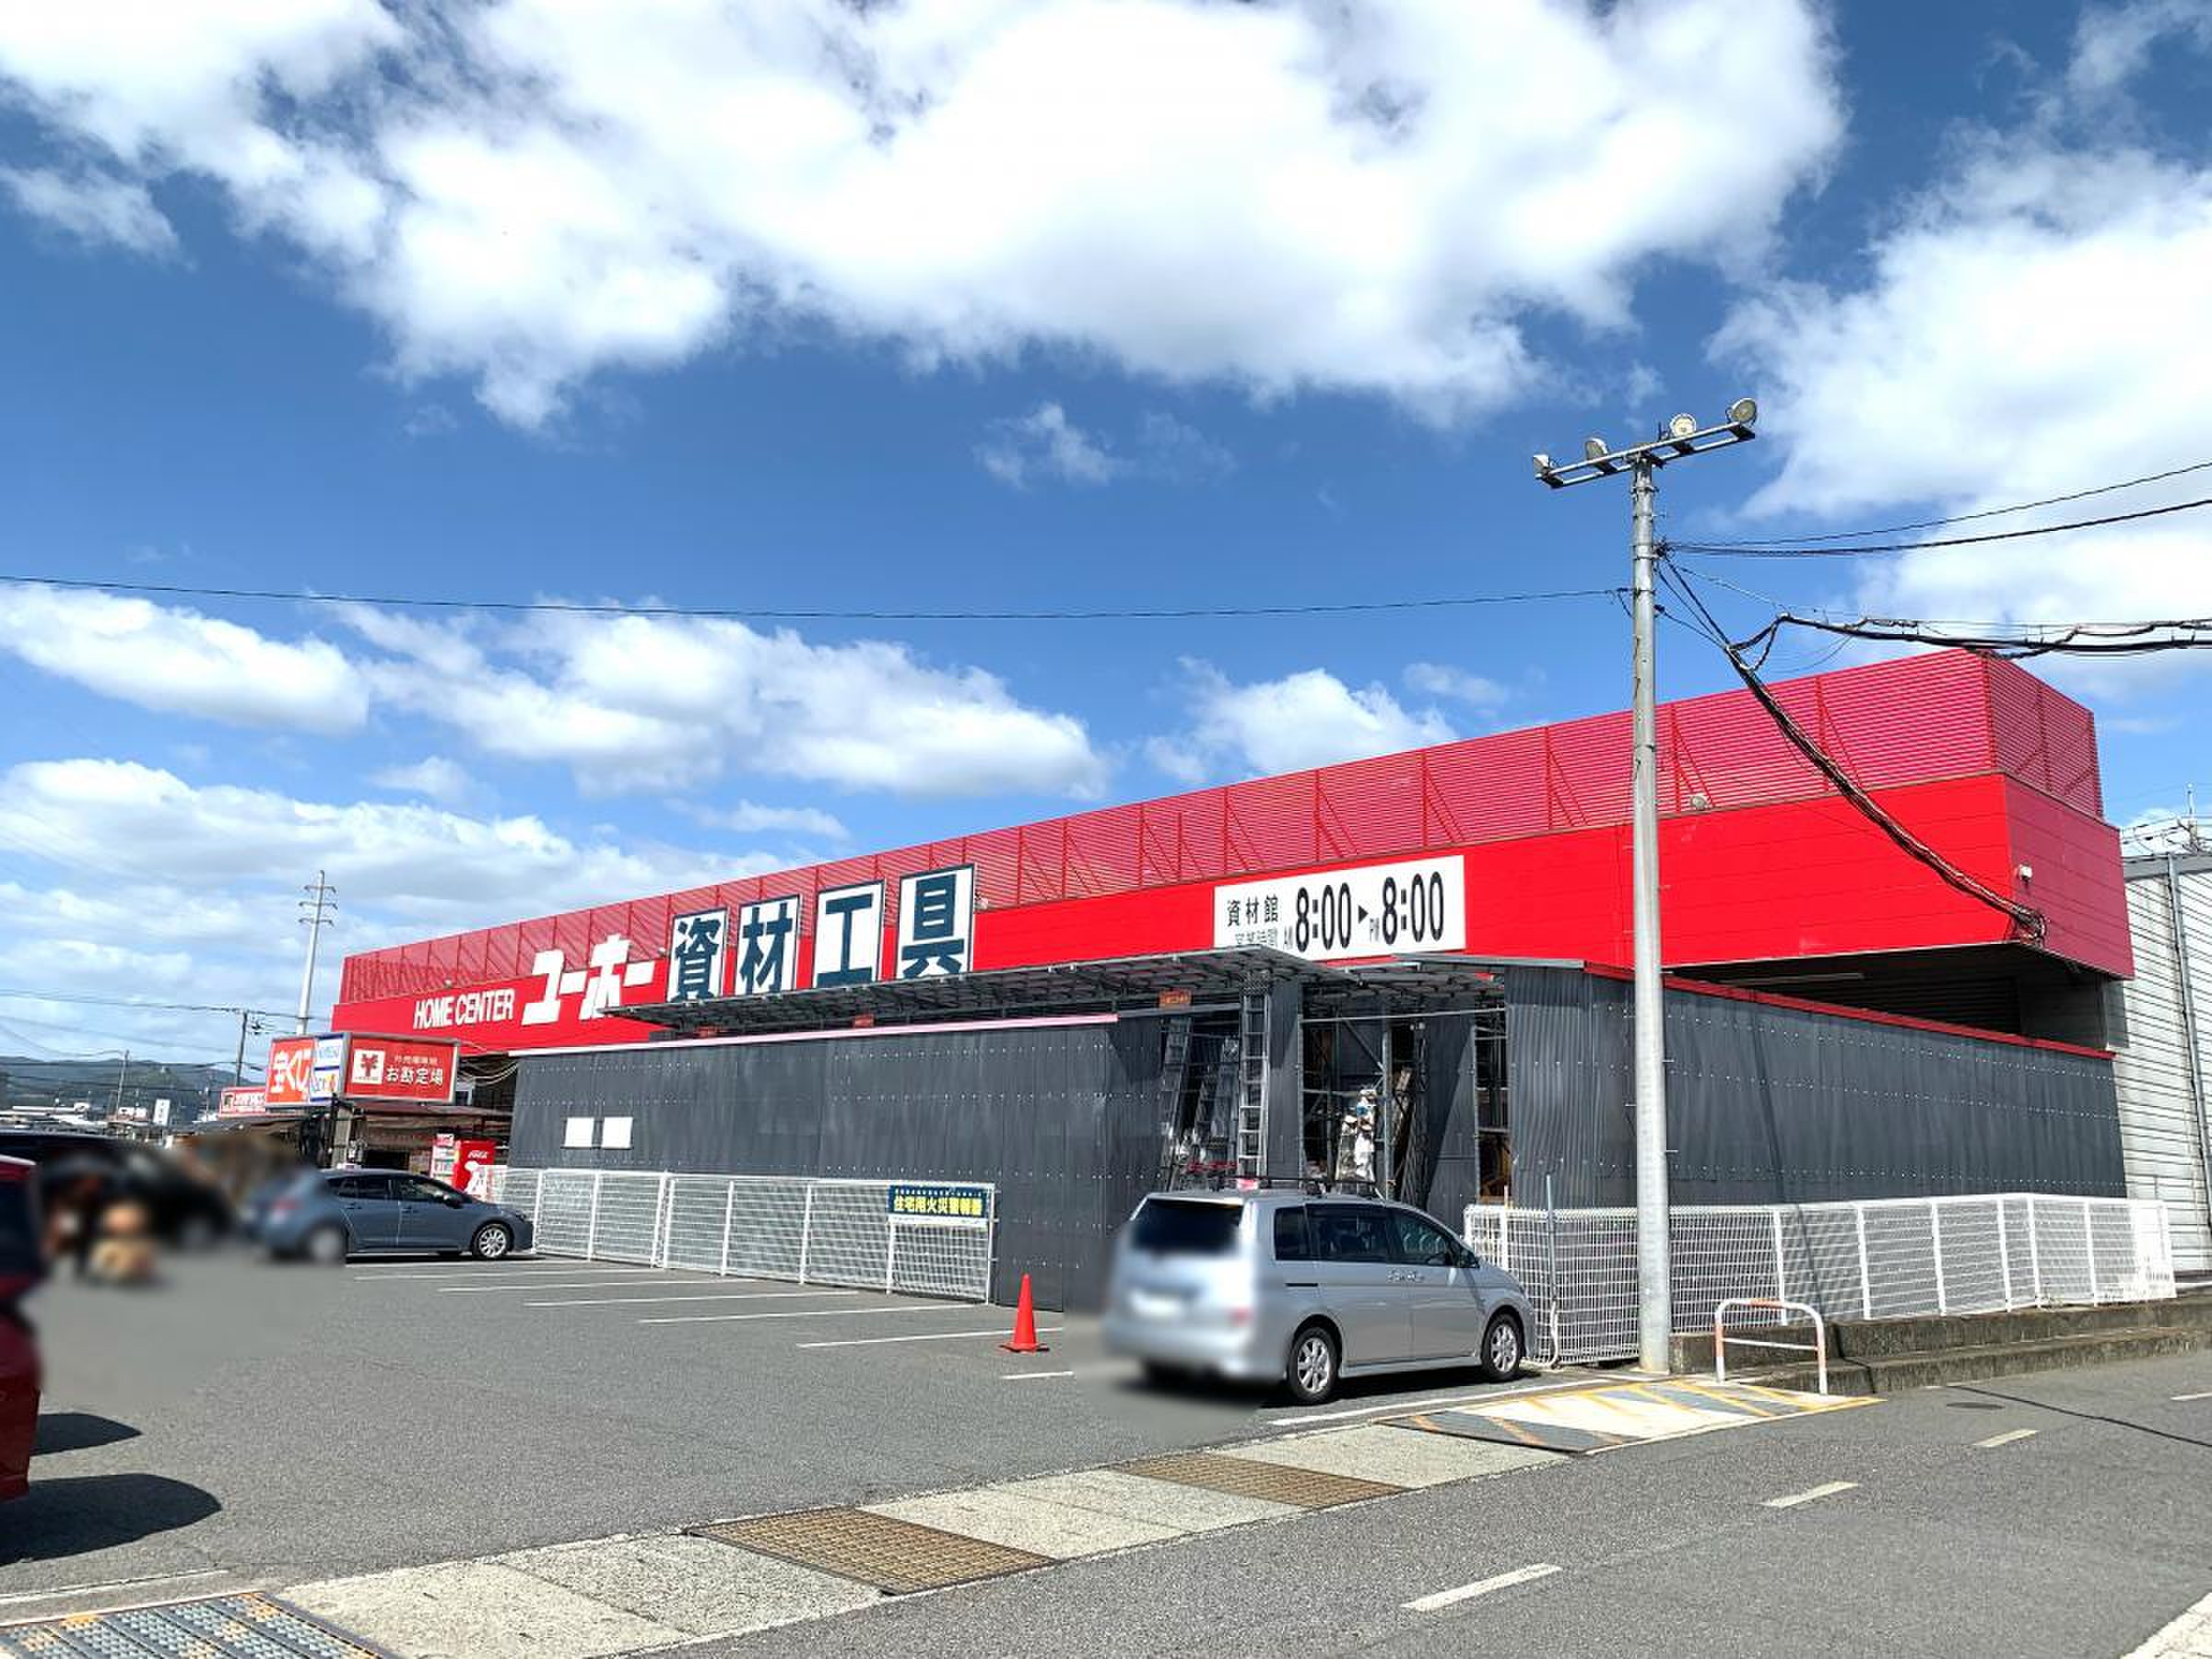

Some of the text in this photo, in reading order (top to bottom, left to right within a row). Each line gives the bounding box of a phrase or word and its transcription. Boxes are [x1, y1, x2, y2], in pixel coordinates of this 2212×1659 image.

[675, 874, 966, 1001] 資材工具
[1227, 894, 1278, 927] 資材館
[1295, 882, 1352, 953] 8:00
[1382, 871, 1444, 946] 8:00
[413, 988, 516, 1030] HOME CENTER
[522, 934, 655, 1026] ユーホー
